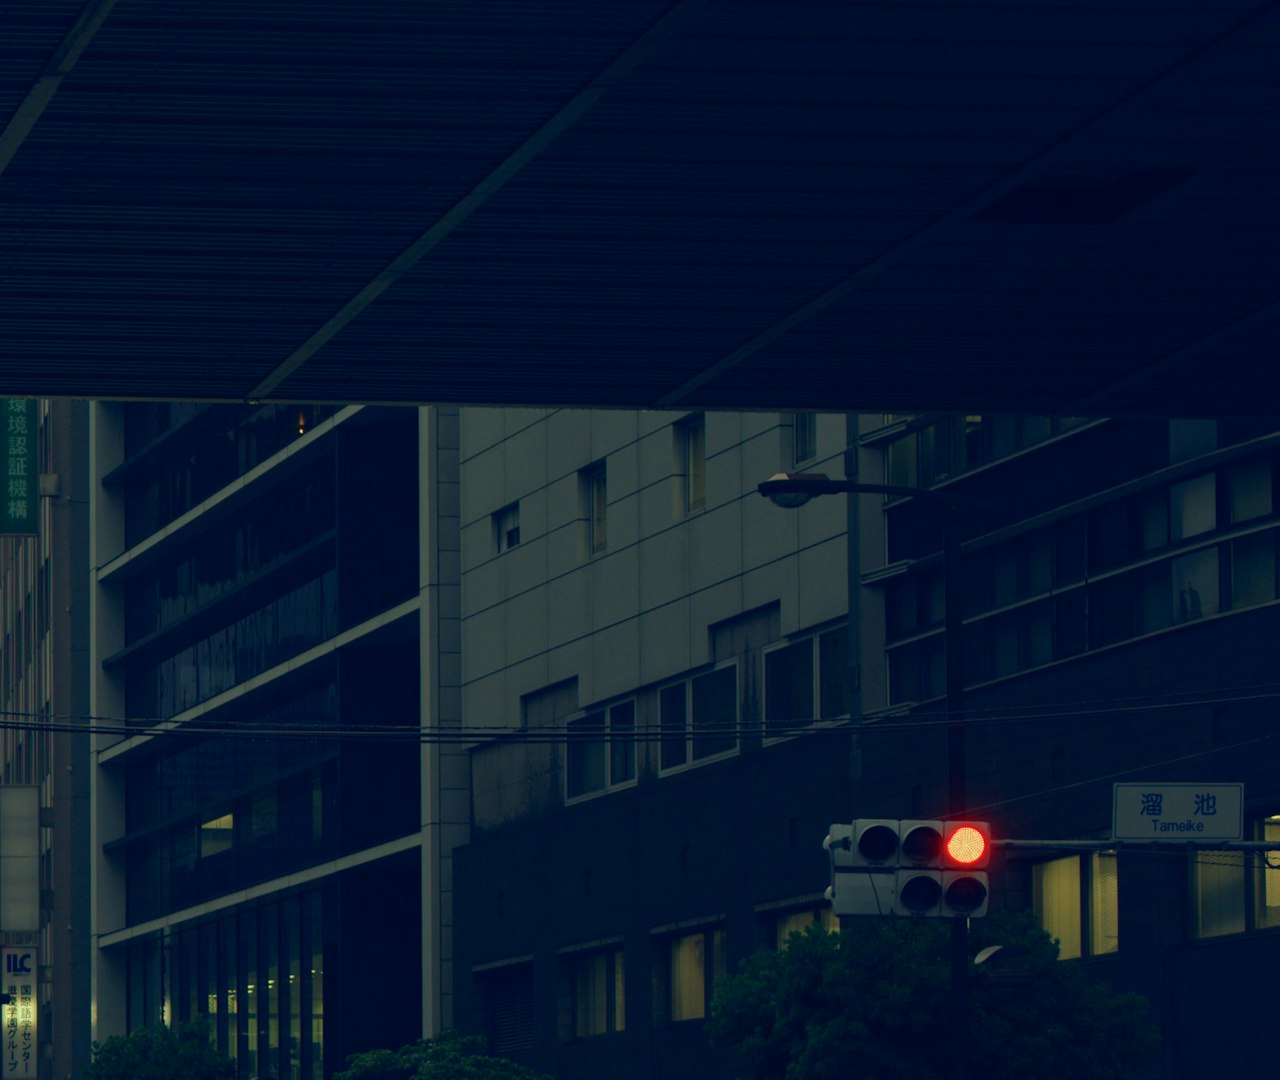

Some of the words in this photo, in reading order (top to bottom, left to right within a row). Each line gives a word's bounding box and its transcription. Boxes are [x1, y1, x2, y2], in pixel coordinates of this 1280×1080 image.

[1140, 793, 1217, 816] 溜池
[1152, 819, 1204, 832] Tameike
[7, 953, 31, 972] ILC
